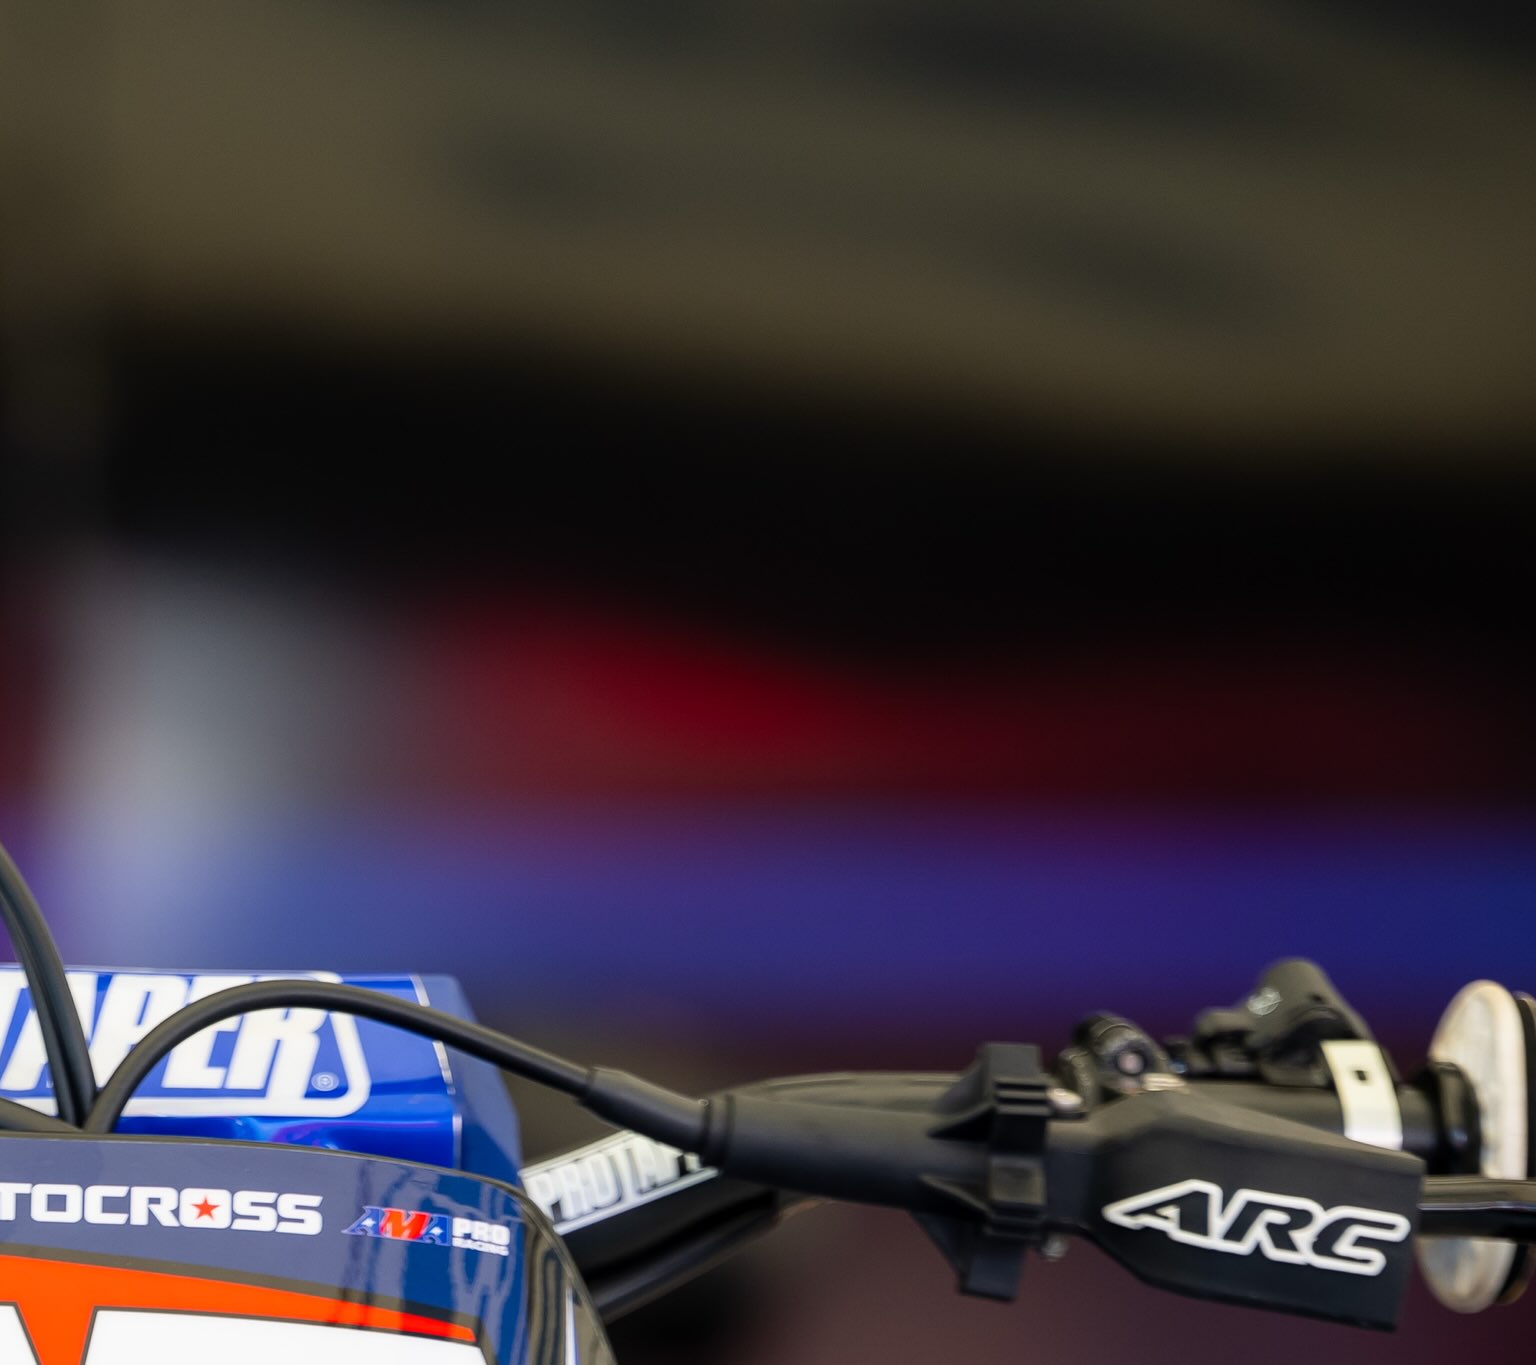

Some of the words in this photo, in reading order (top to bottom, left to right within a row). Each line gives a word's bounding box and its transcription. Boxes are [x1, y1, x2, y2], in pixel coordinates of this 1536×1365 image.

[341, 1204, 452, 1247] AMA
[452, 1217, 511, 1246] PRO
[1101, 1178, 1411, 1277] ARC
